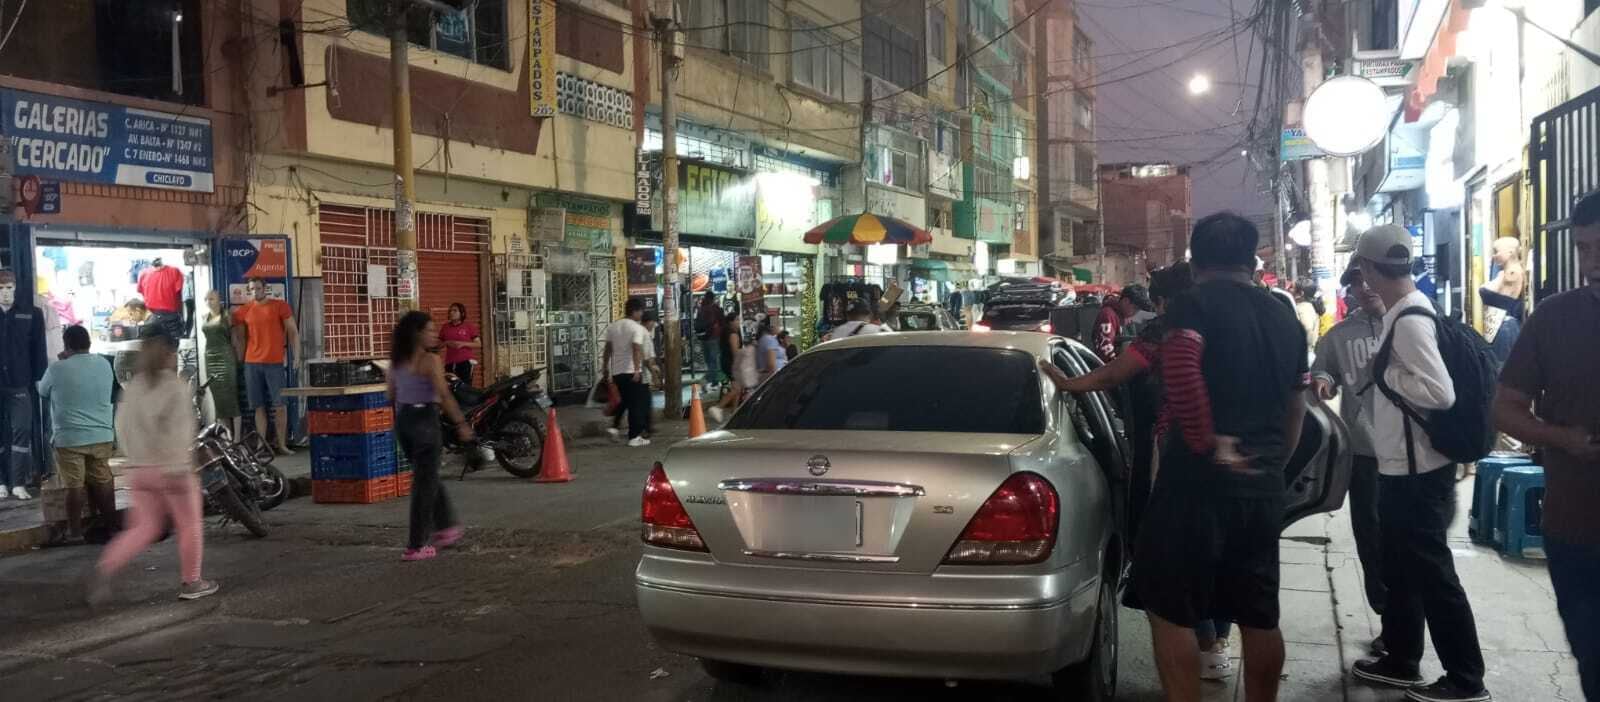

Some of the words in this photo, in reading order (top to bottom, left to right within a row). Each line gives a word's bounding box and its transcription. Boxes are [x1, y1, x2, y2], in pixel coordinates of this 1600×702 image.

[14, 100, 109, 138] GALERIAS
[11, 135, 111, 174] "CERCADO"
[153, 173, 185, 185] CHICLAYO
[232, 248, 250, 257] BCP
